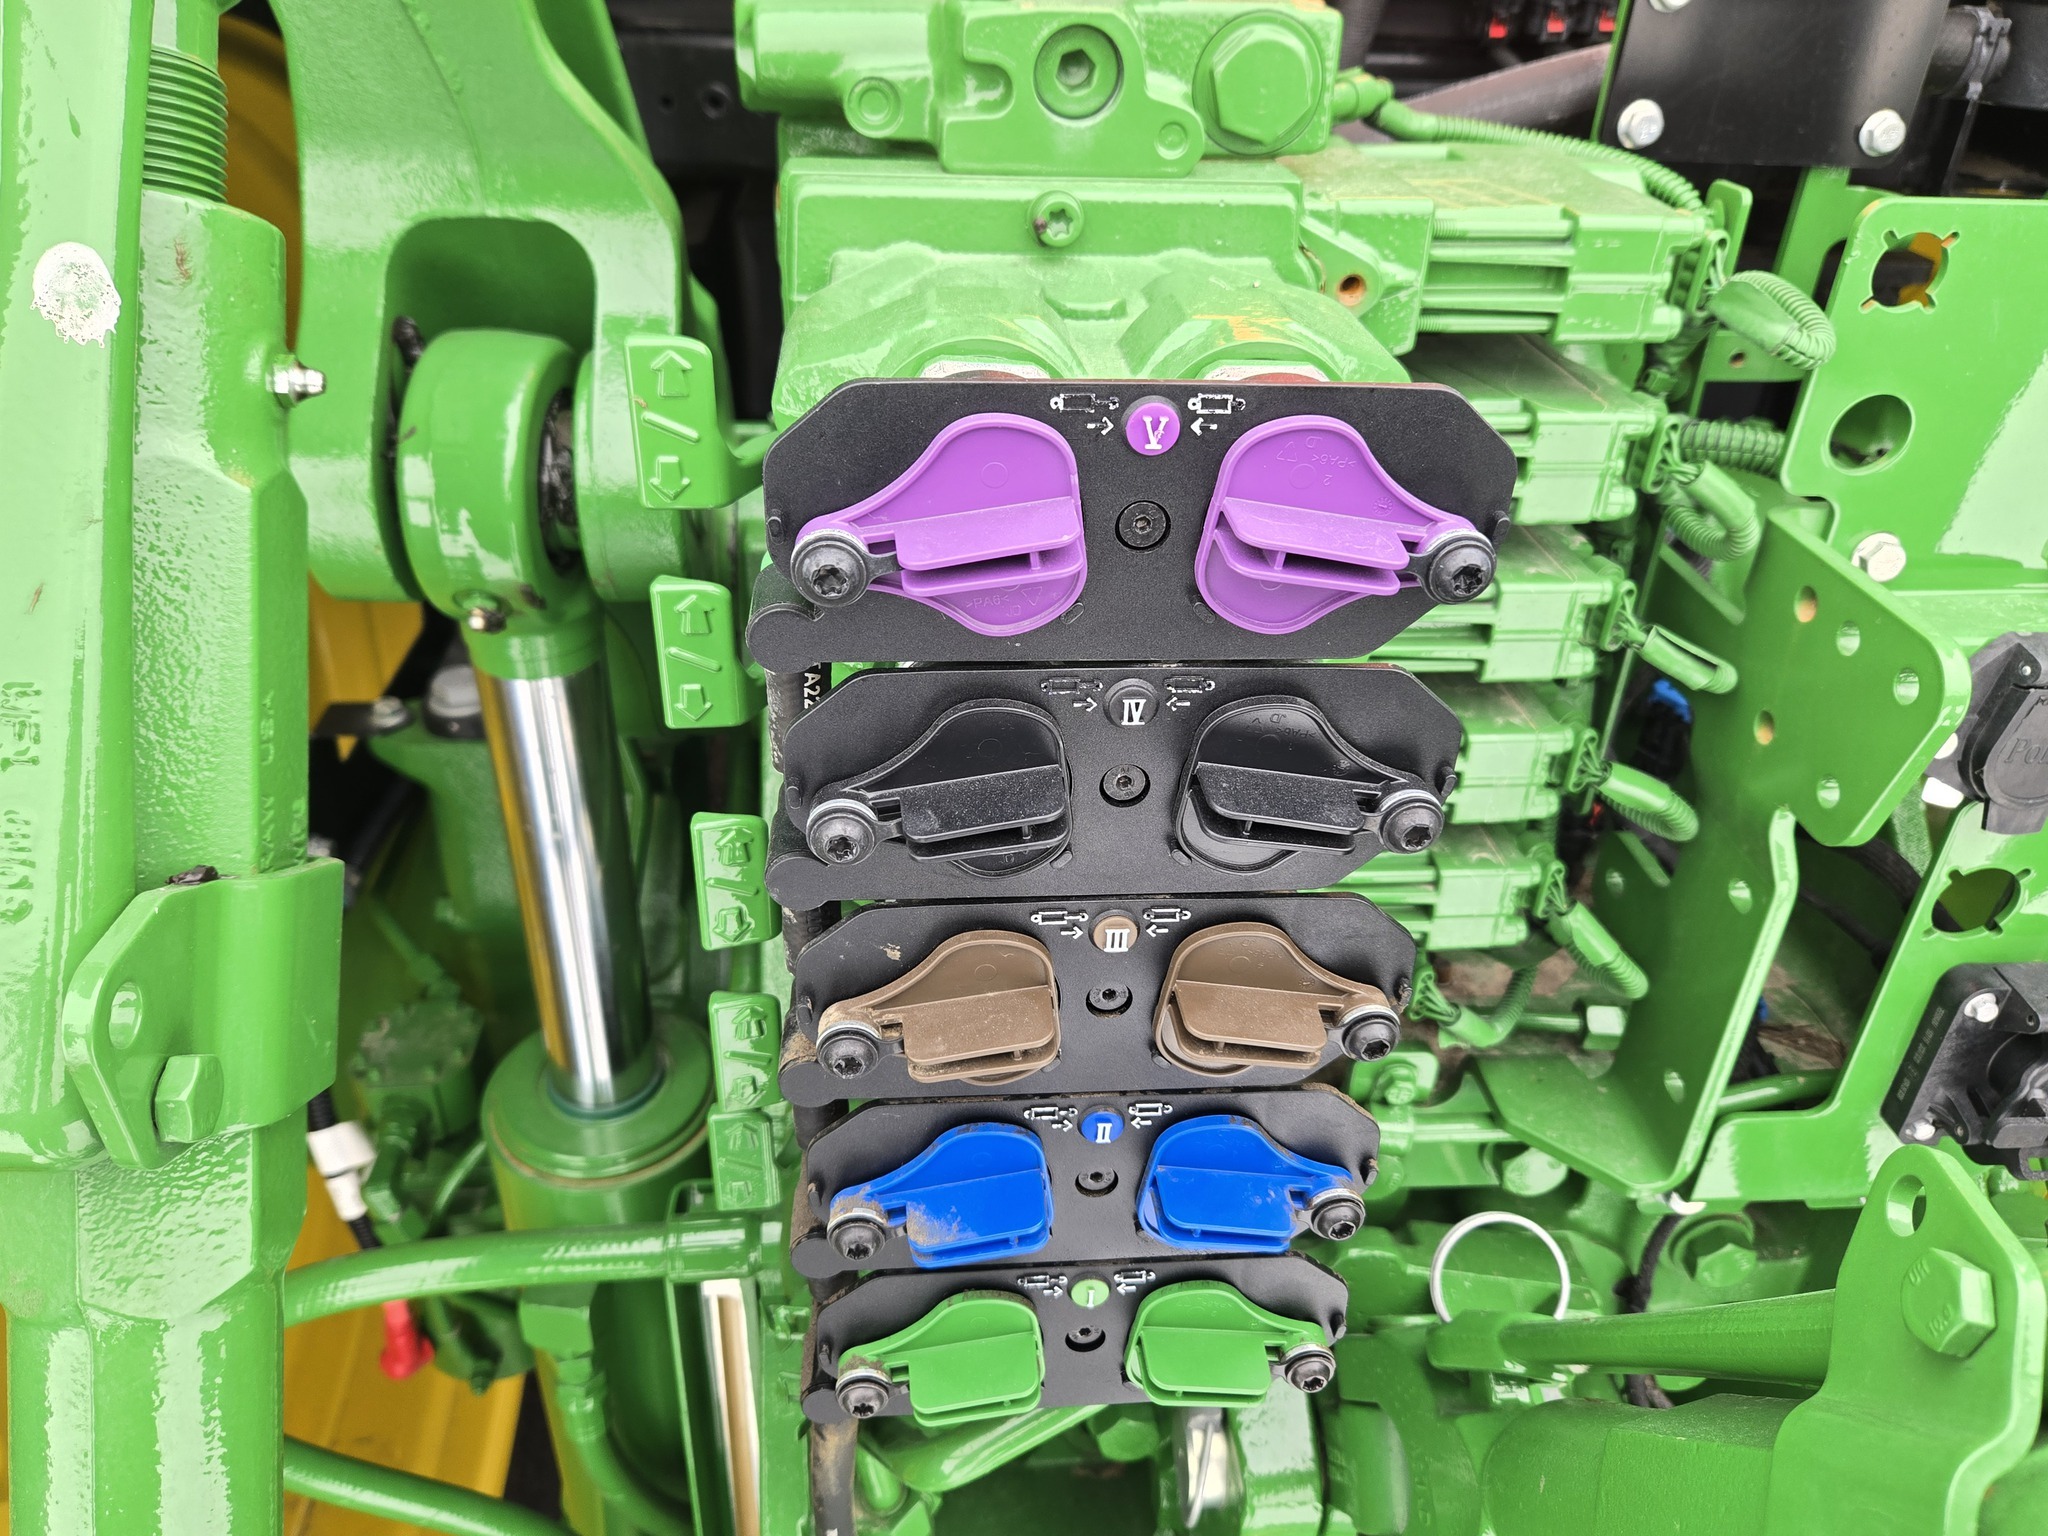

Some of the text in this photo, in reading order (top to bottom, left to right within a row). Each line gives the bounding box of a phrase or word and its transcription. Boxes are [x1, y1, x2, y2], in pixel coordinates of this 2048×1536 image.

[1142, 415, 1170, 450] V
[1121, 698, 1147, 726] IV
[1103, 928, 1131, 953] III
[1095, 1122, 1113, 1144] II
[1086, 1289, 1096, 1310] I
